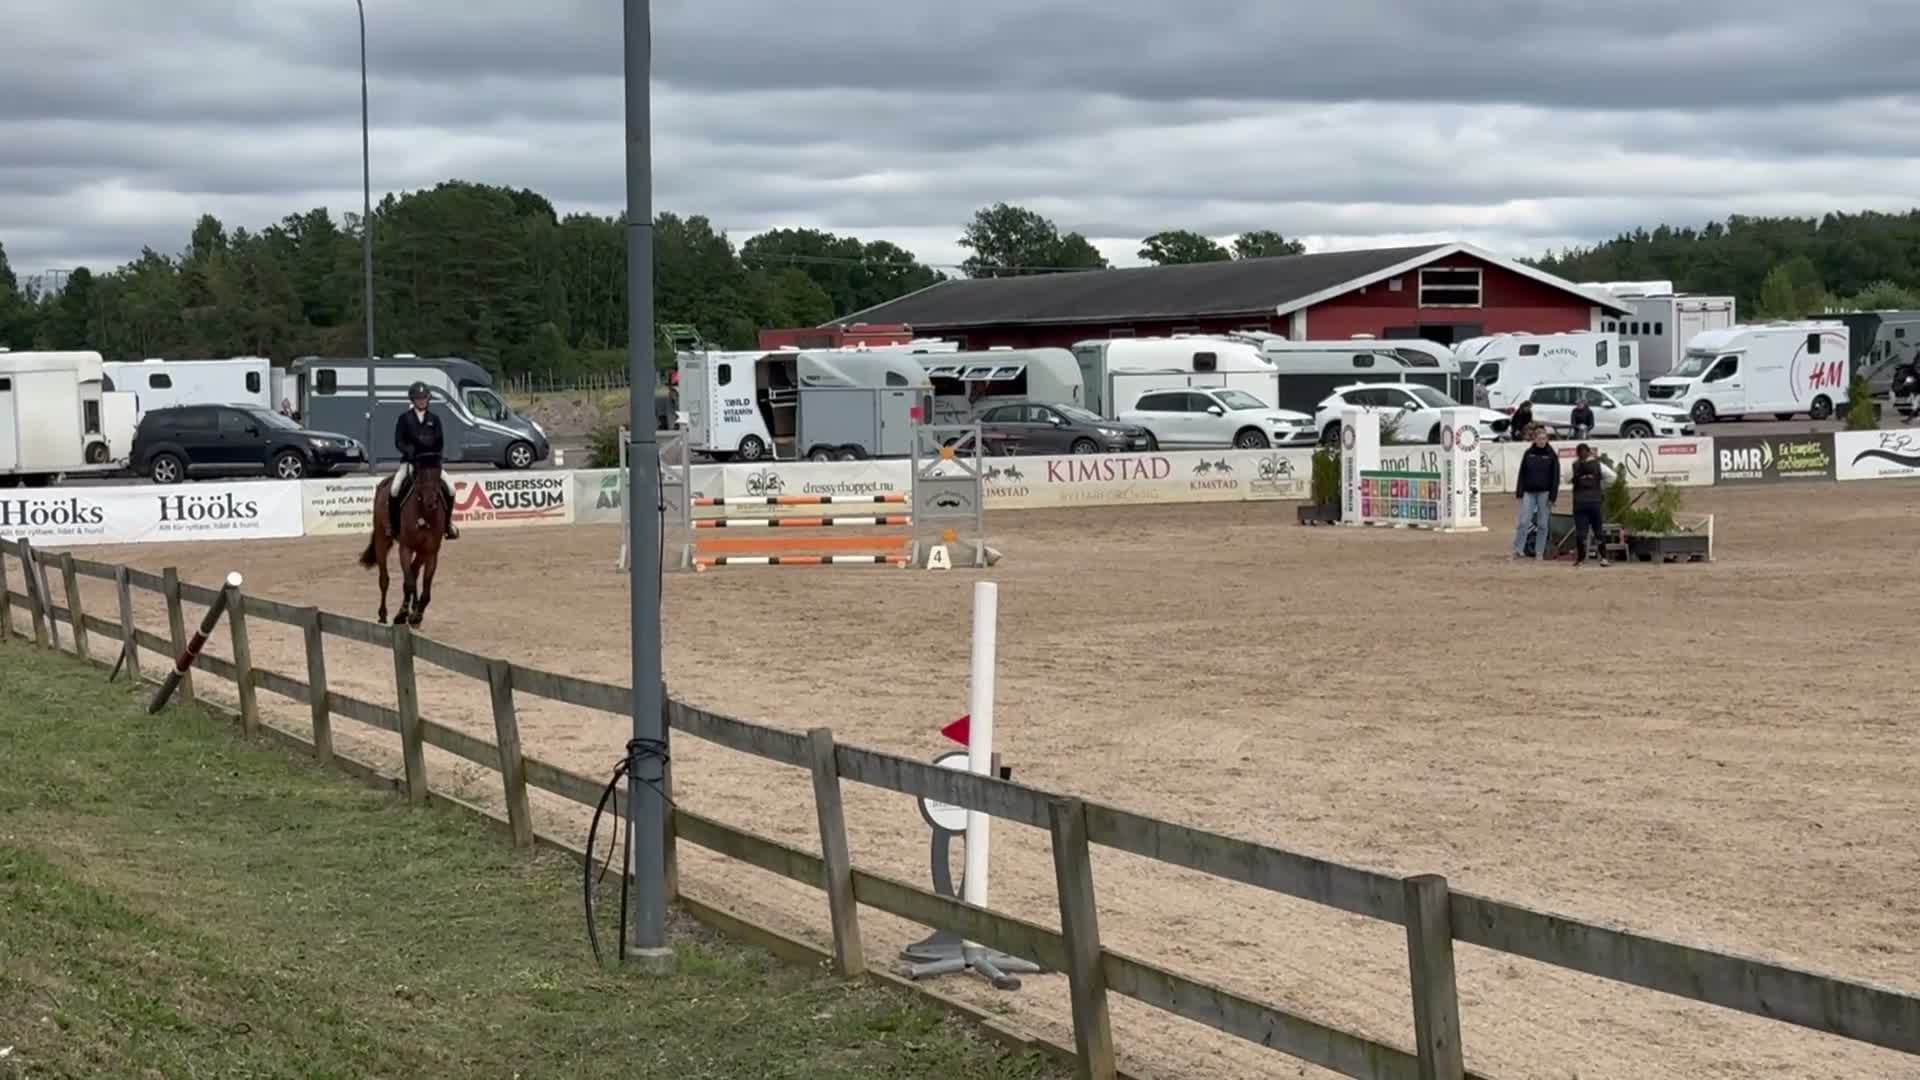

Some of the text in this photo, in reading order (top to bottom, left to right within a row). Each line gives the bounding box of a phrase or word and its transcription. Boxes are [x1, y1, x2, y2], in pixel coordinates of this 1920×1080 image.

[1720, 448, 1762, 470] BMR
[1048, 457, 1171, 482] KIMSTAD
[485, 479, 563, 491] BIRGERSSON
[986, 487, 1029, 497] IMSTAD
[1190, 480, 1238, 490] KIMSTAD
[157, 492, 258, 521] Hööks
[490, 491, 563, 509] GUSUM
[0, 498, 104, 525] Hööks
[934, 550, 942, 563] 4
